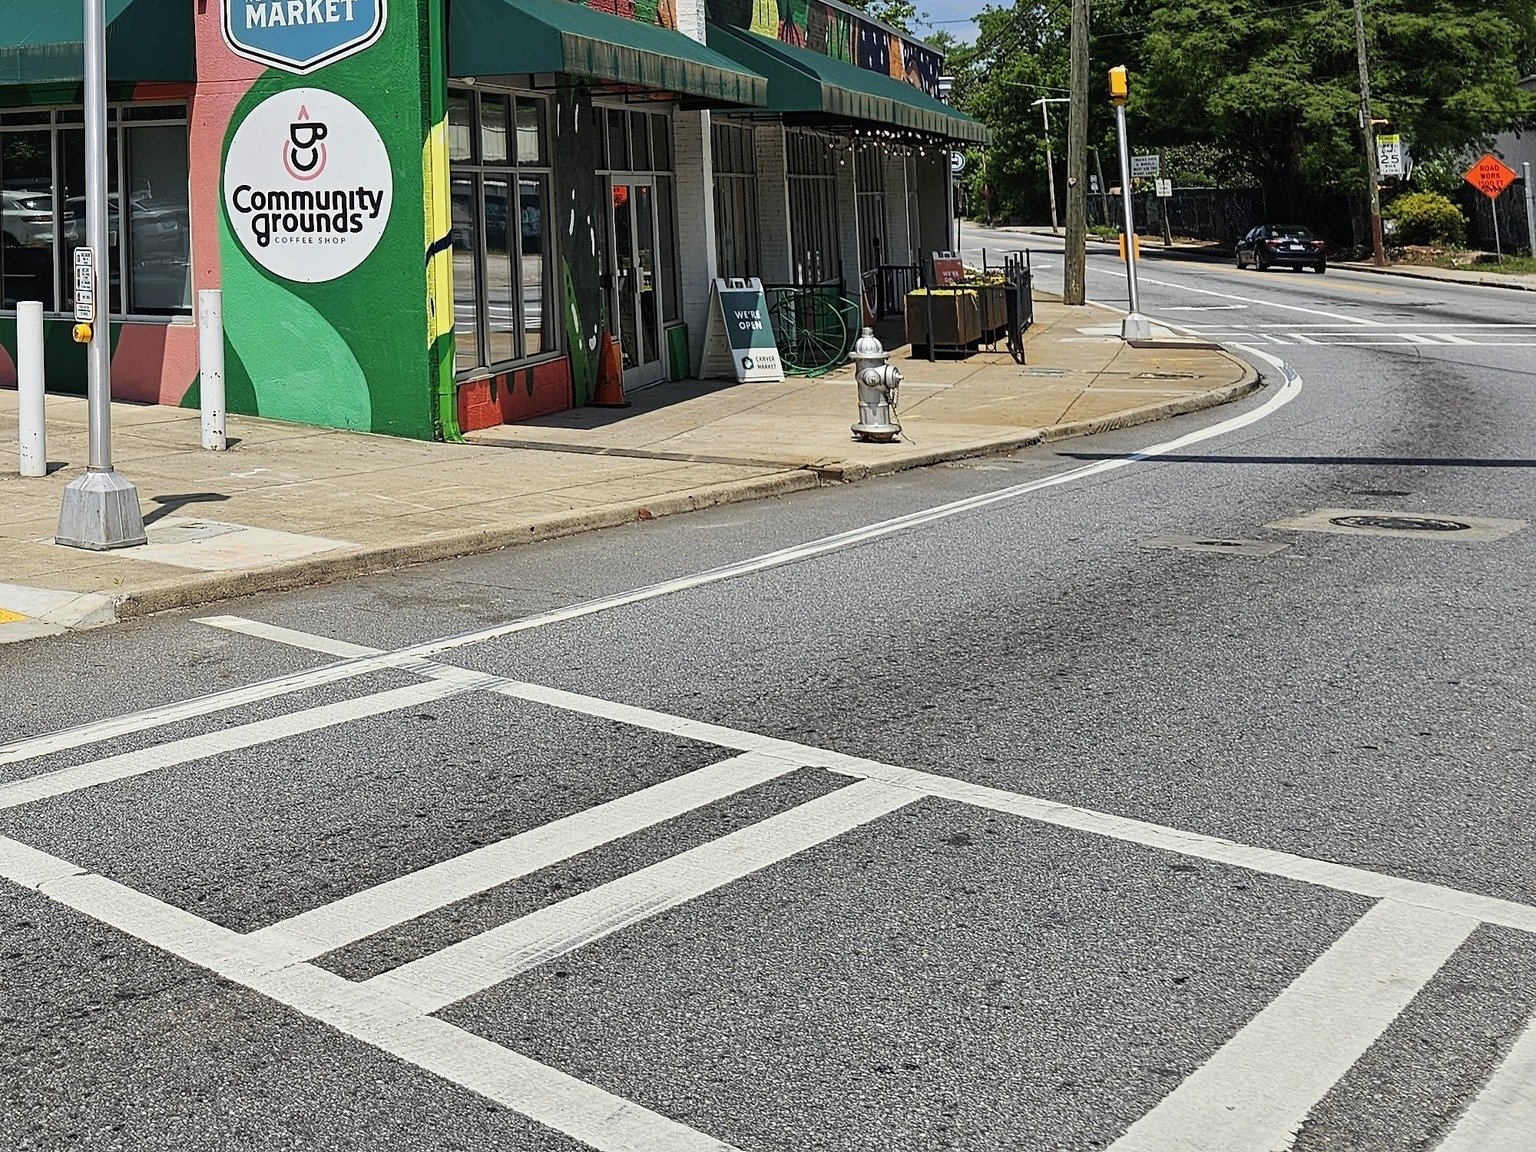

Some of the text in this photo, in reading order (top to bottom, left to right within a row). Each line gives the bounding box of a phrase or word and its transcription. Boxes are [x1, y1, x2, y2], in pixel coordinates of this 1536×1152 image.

[1381, 154, 1399, 164] 25
[233, 185, 383, 218] Community
[252, 213, 363, 247] grounds
[735, 310, 761, 319] WE'RE
[739, 321, 762, 330] OPEN
